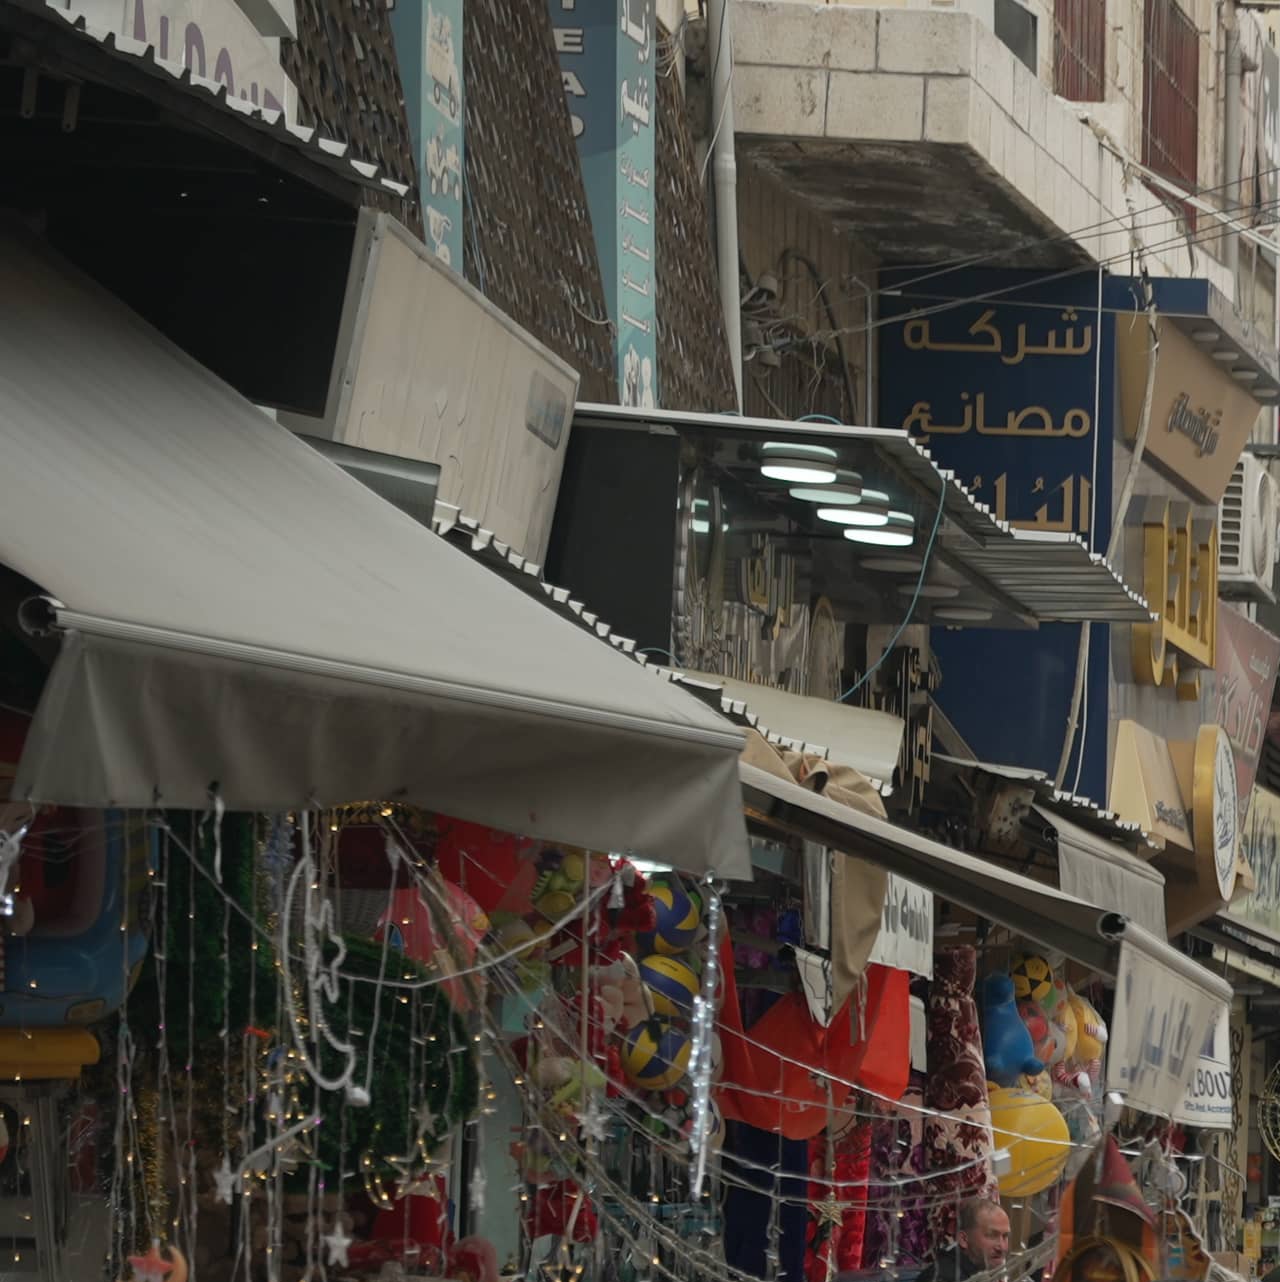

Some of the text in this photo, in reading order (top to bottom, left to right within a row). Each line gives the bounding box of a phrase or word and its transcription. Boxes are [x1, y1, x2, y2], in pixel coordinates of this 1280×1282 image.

[620, 77, 651, 137] غنيم
[902, 305, 1093, 365] شركة
[901, 391, 1092, 444] مصانع
